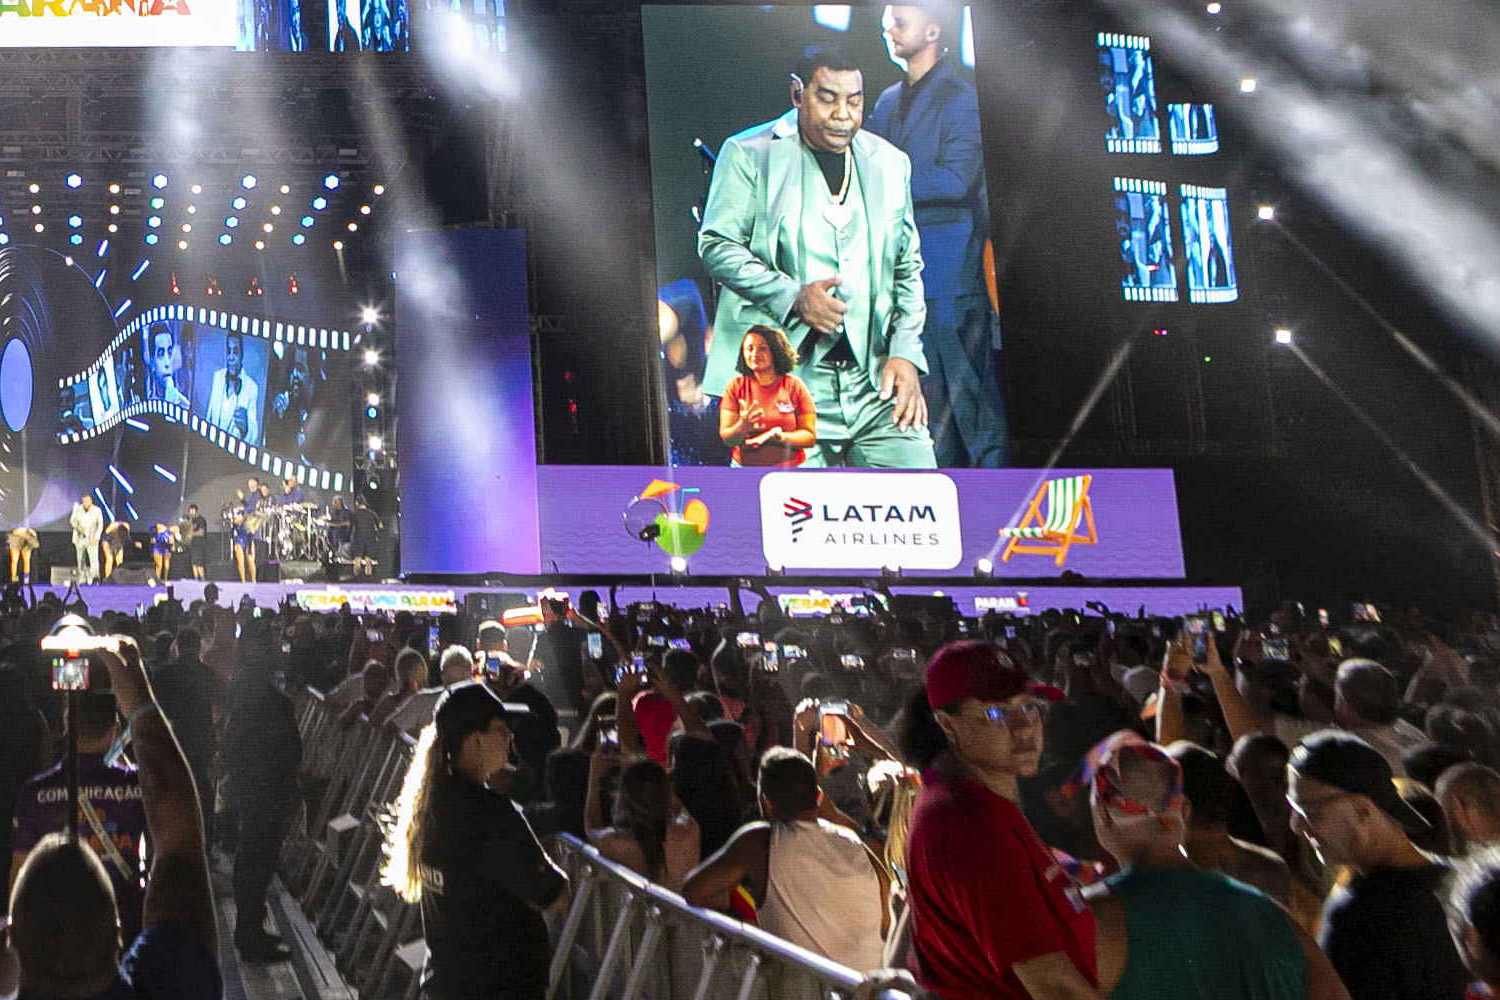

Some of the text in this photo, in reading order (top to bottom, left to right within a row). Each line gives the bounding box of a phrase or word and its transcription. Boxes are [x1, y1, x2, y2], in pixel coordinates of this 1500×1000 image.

[823, 505, 937, 522] LATAM
[825, 533, 939, 545] AIRLINES
[37, 784, 142, 804] COMNICAÇÃO
